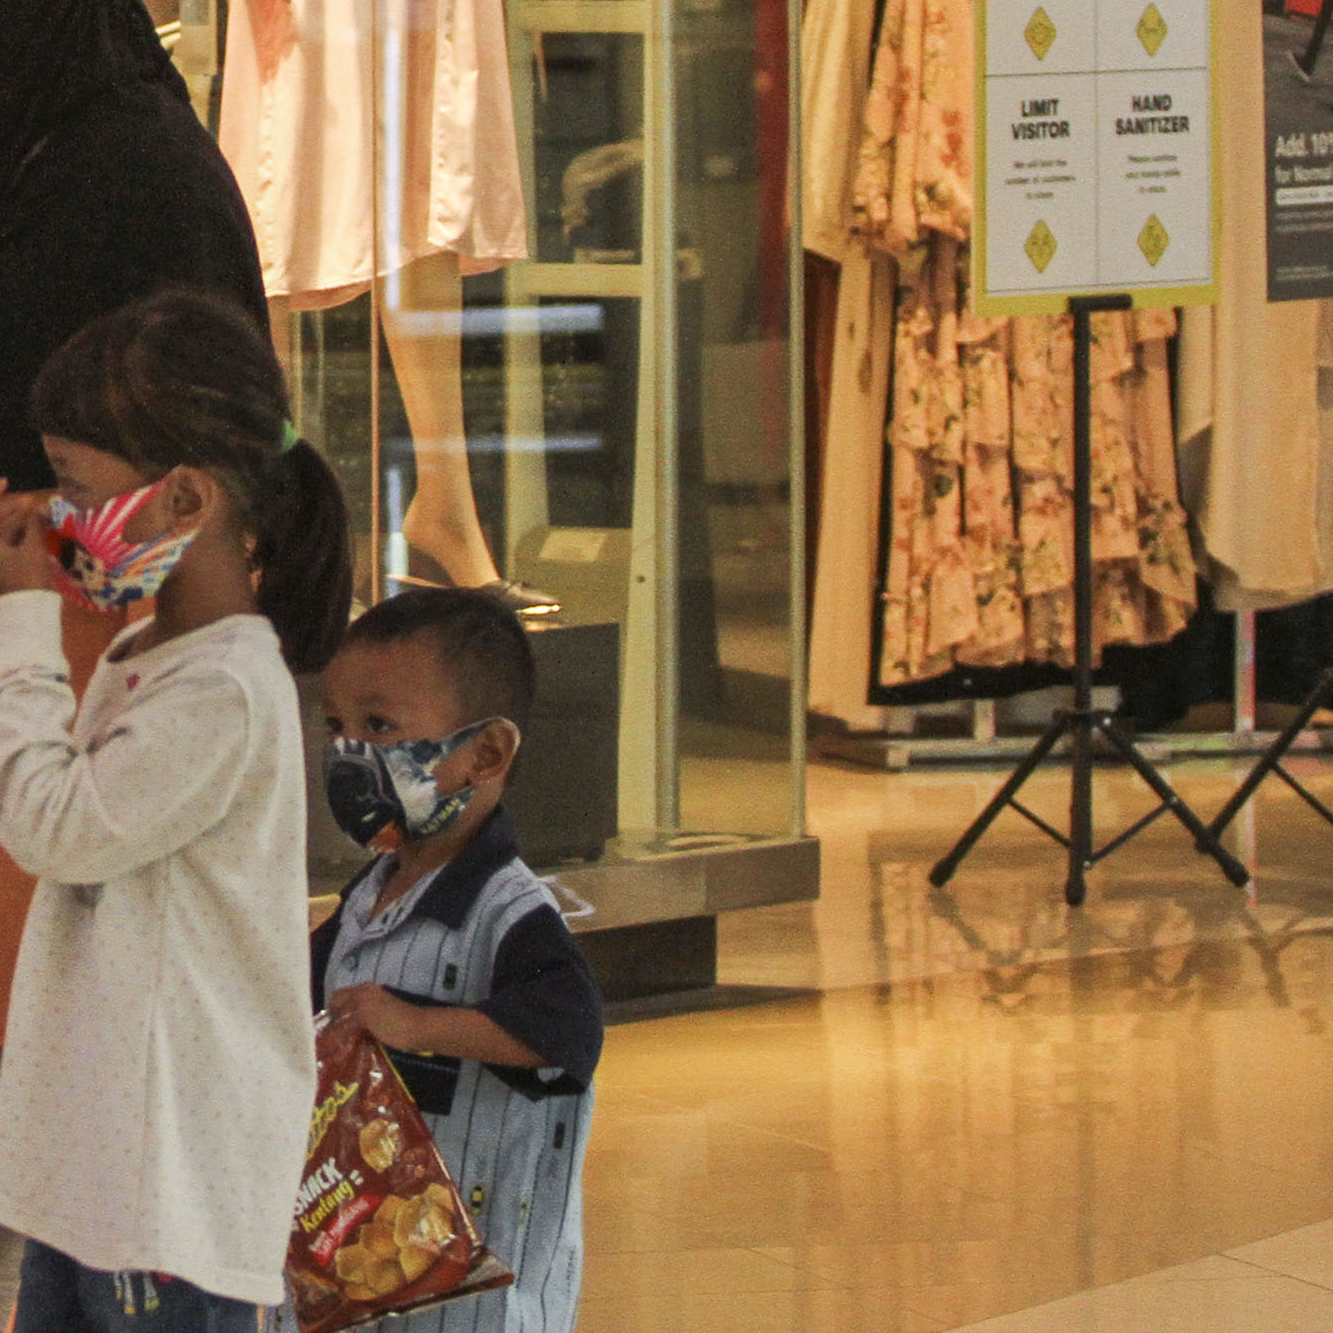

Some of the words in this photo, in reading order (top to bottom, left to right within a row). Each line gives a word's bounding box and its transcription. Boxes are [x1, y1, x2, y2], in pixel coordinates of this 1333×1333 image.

[1021, 99, 1060, 117] LIMIT
[1131, 94, 1172, 112] HAND
[1011, 121, 1070, 140] VISITOR
[1115, 116, 1190, 135] SANITIZER
